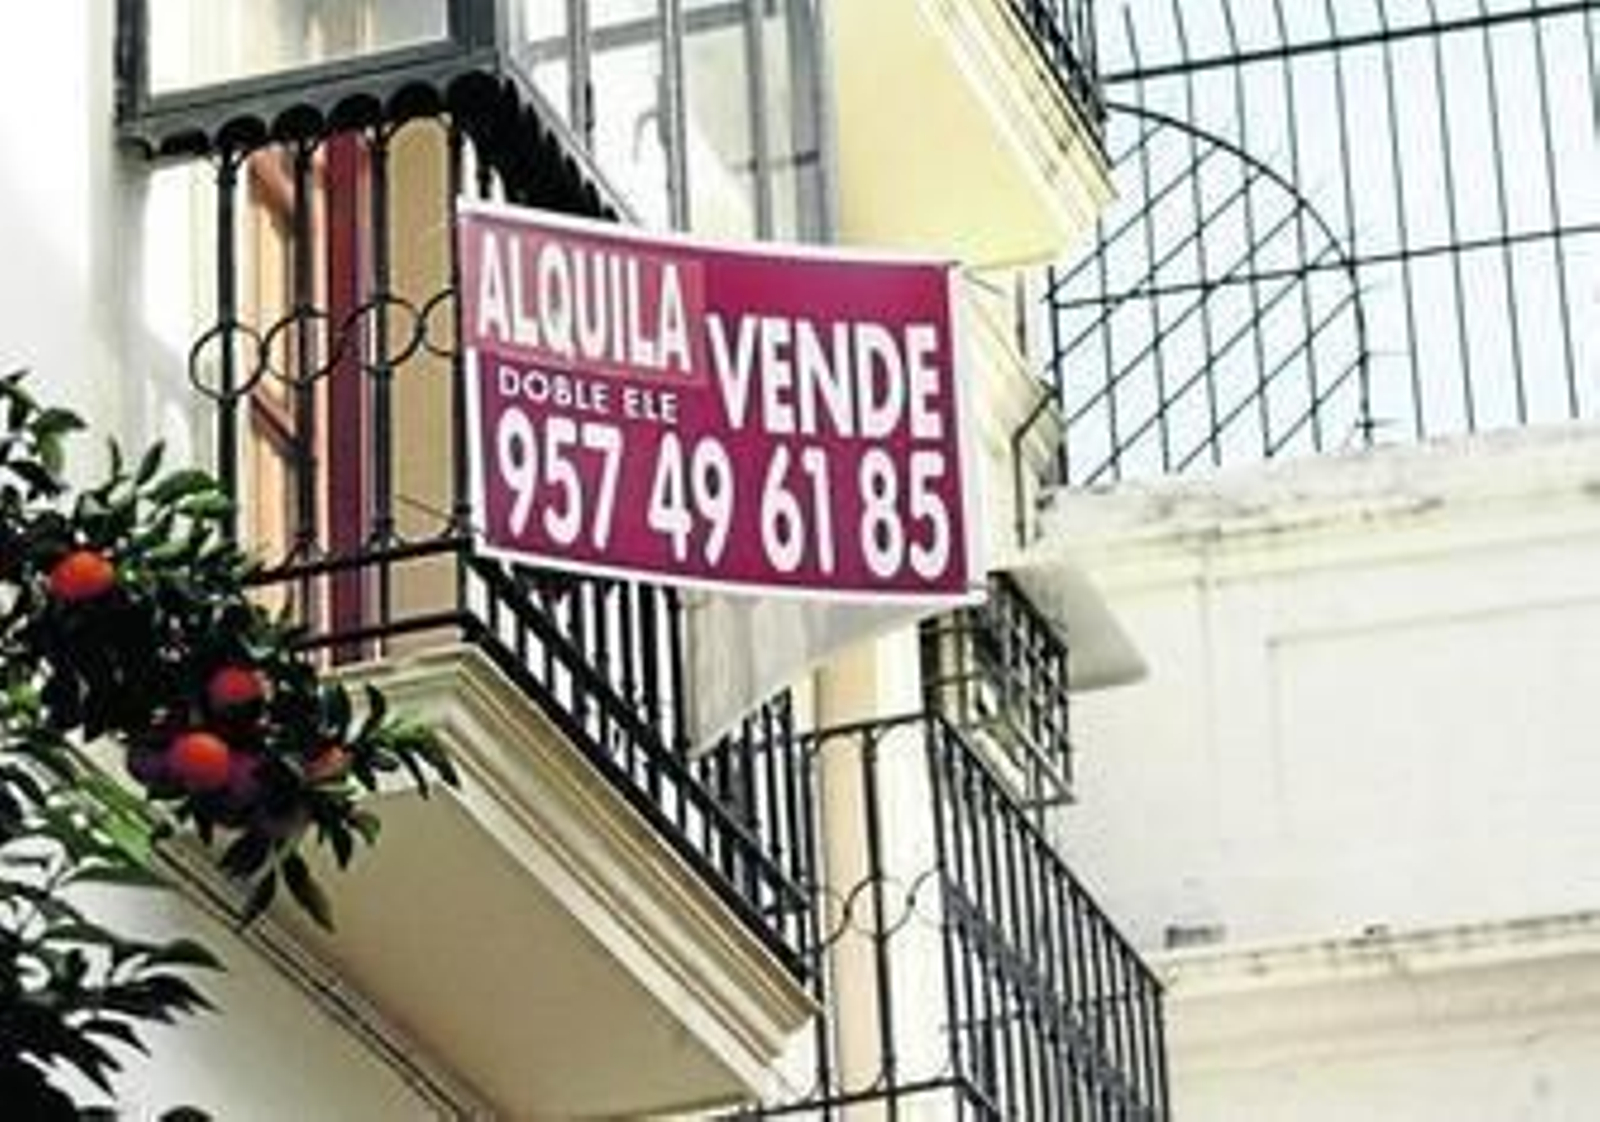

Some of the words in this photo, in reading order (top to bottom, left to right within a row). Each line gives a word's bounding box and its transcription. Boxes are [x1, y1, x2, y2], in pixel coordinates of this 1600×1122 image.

[477, 230, 692, 373] ALQUILA
[499, 366, 609, 413] DOBLE
[624, 387, 678, 425] ELE
[706, 314, 944, 439] VENDE
[498, 407, 623, 550] 957
[647, 432, 734, 567] 49
[761, 445, 834, 573] 61
[859, 448, 950, 579] 85
